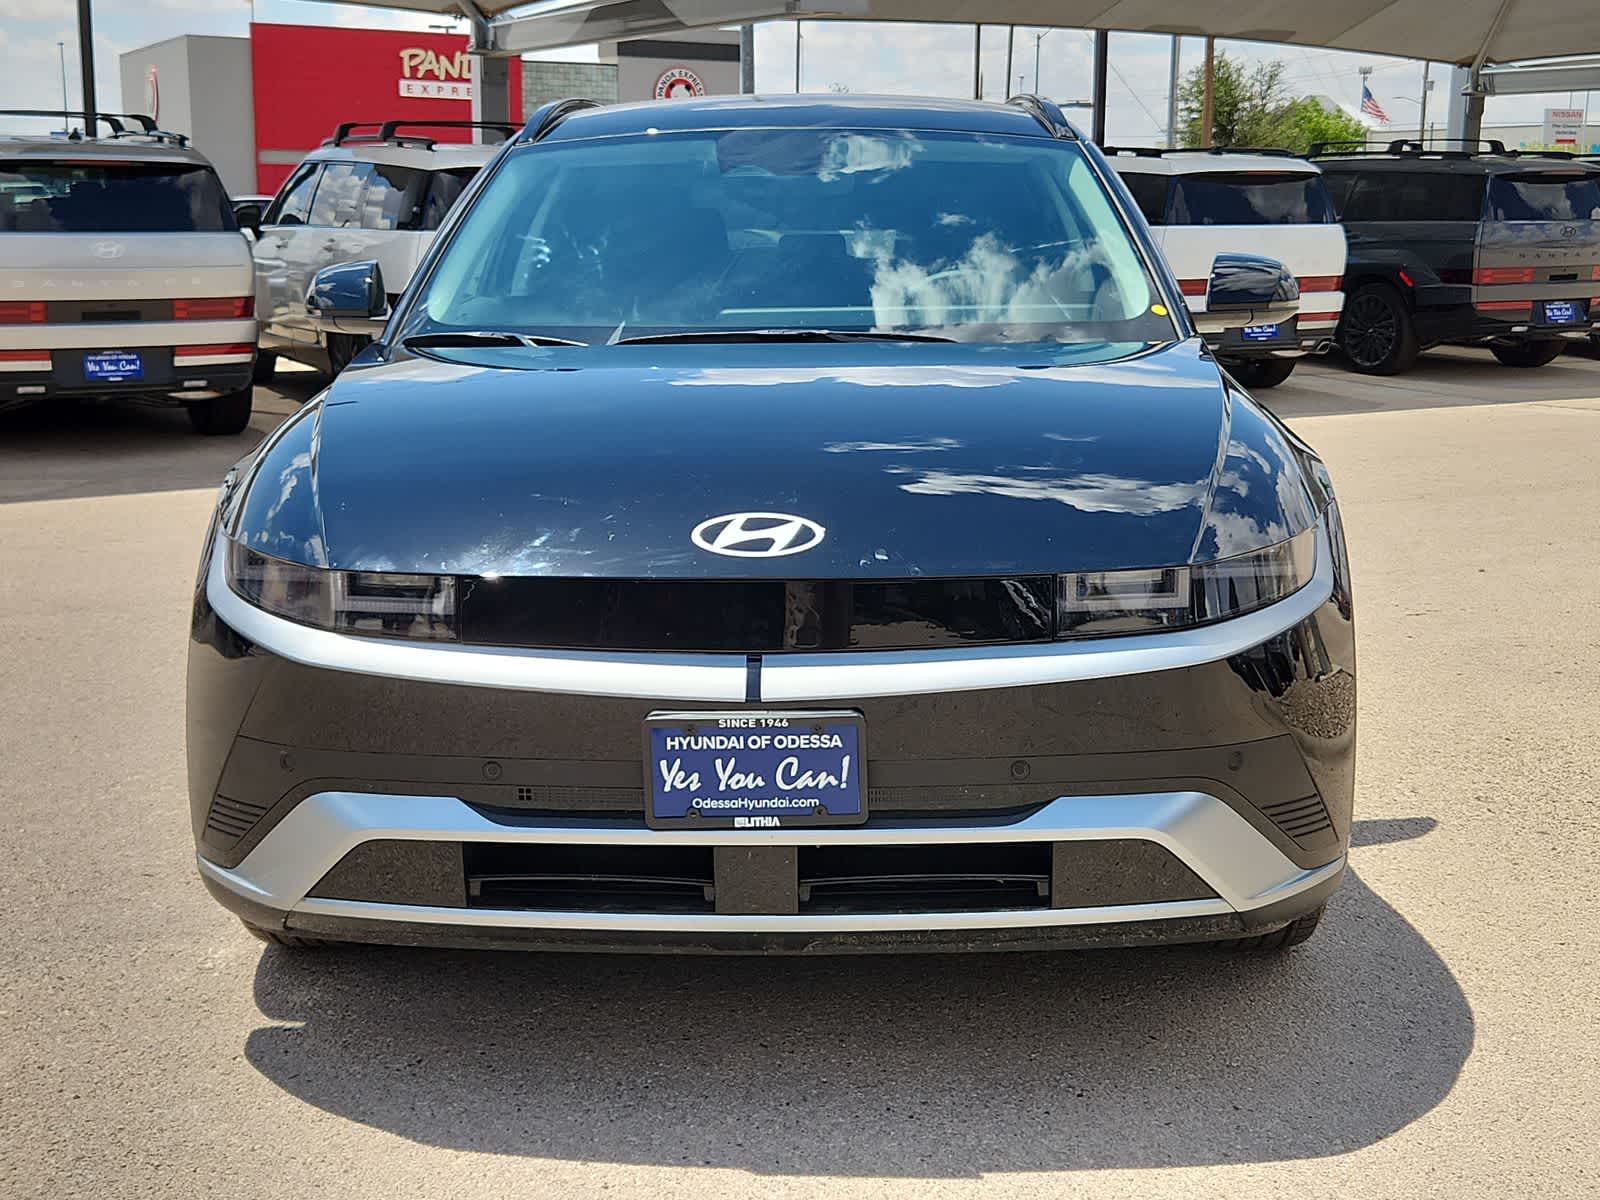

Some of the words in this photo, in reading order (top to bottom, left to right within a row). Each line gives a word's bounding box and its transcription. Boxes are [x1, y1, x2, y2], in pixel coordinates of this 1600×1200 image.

[399, 47, 472, 80] PAND
[406, 83, 472, 97] EXPRE
[718, 719, 756, 728] SINCE
[760, 718, 789, 727] 1946
[666, 736, 744, 750] HYUNDAI
[747, 736, 771, 749] OF
[773, 735, 843, 749] ODESSA
[659, 758, 702, 793] Yes
[714, 757, 766, 792] You
[775, 755, 851, 791] Can!
[692, 797, 820, 811] OdessaHyundai.com
[744, 816, 781, 827] LITHIA
